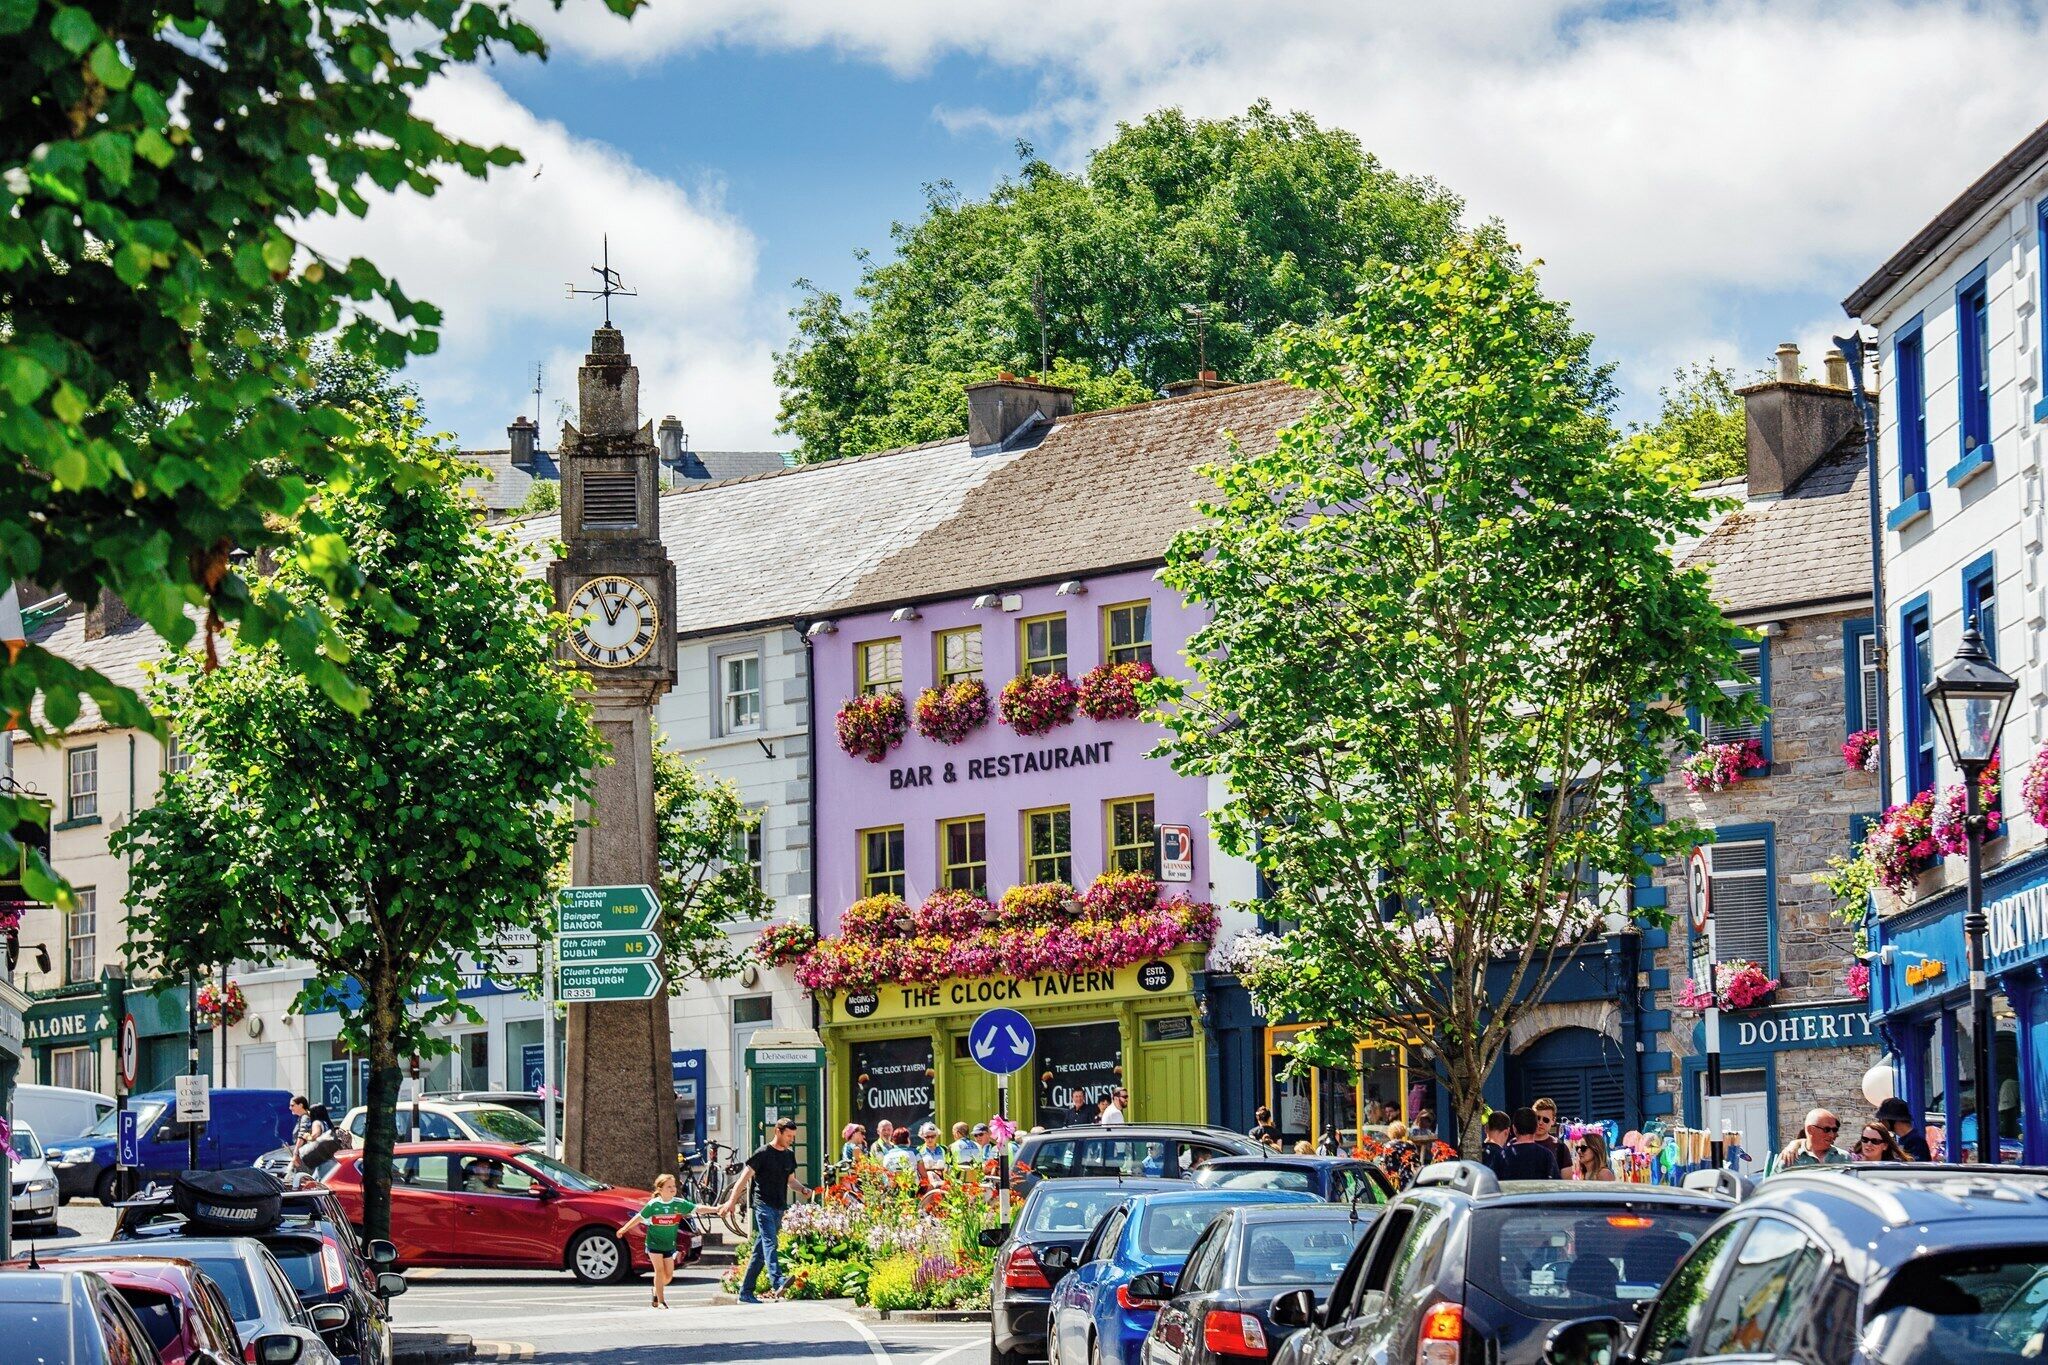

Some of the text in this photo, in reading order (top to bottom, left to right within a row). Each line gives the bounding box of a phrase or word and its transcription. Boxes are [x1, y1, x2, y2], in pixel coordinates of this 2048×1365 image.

[889, 741, 1113, 790] BAR & RESTAURANT
[562, 900, 603, 908] CLIFDEN
[563, 921, 603, 930] BANGOR
[580, 938, 607, 947] Cliath
[563, 949, 598, 957] DUBLIN
[1145, 966, 1166, 976] ESTD.
[563, 976, 625, 986] LOUISBURGH
[1144, 976, 1167, 986] 1976
[901, 971, 1115, 1008] THE CLOCK TAVERN
[854, 1005, 870, 1014] BAR
[28, 1014, 87, 1039] ALONE
[1738, 1012, 1873, 1046] DOHERTY
[871, 1063, 926, 1075] THE CLOCK TAVERN
[1055, 1061, 1114, 1073] THE CLOCK TAVERN
[868, 1086, 928, 1109] GUINNESS
[1052, 1084, 1116, 1108] GUNESS
[125, 1117, 133, 1133] P
[208, 1205, 258, 1220] BULLDOG
